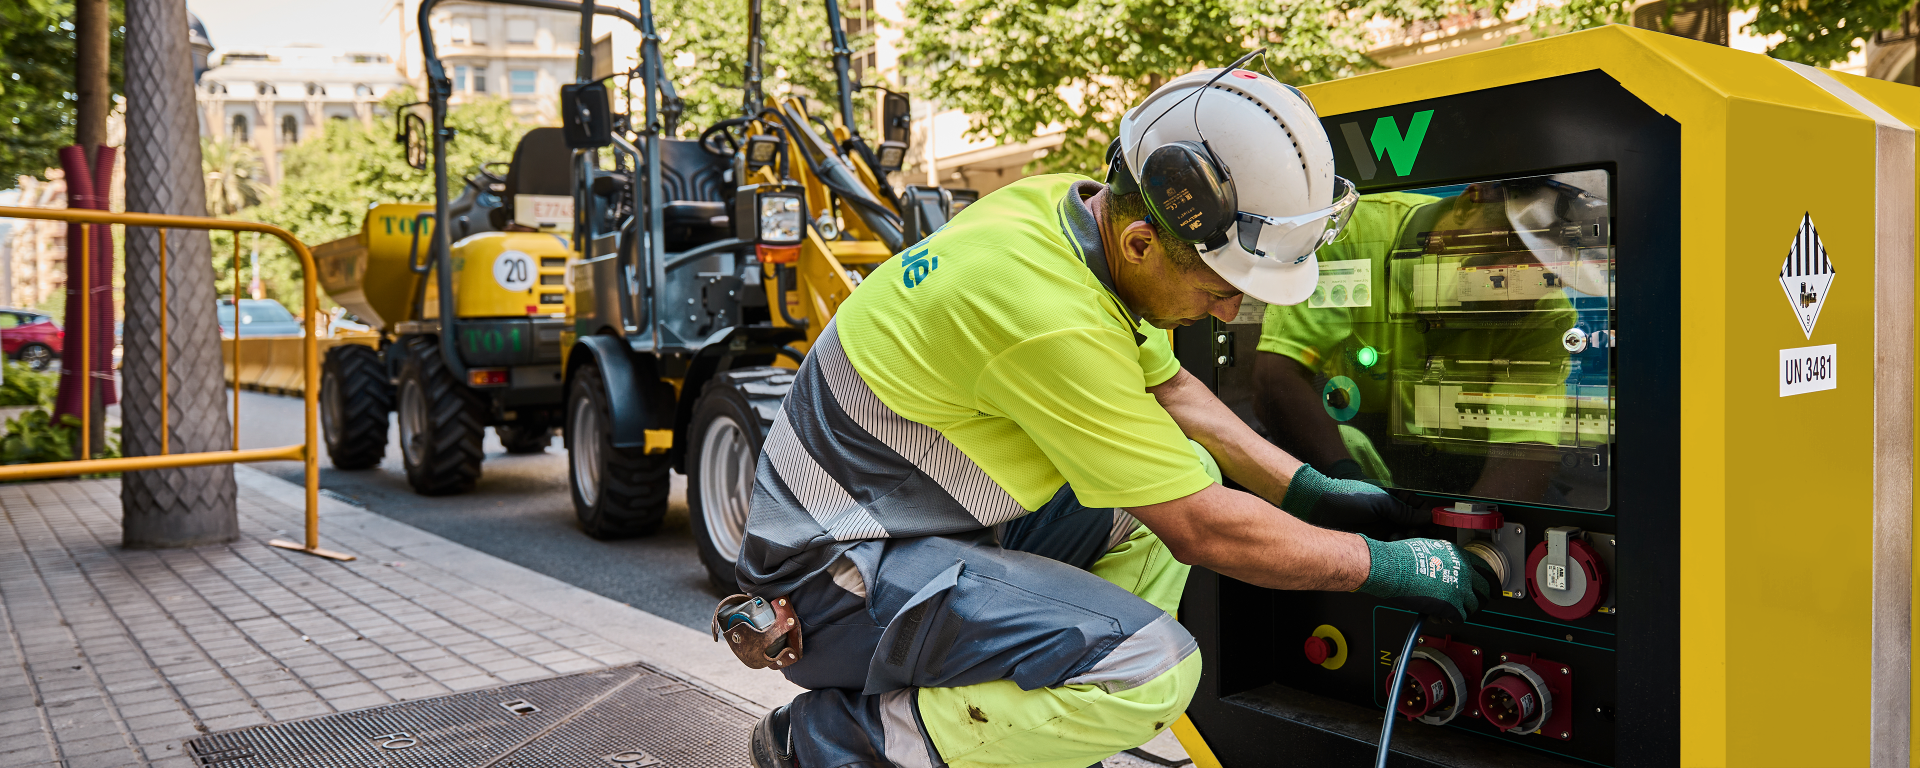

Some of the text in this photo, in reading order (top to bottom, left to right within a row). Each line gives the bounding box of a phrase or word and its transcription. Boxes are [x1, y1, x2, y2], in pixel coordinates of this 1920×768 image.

[1189, 219, 1203, 230] 3M
[504, 258, 527, 283] 20
[1785, 354, 1832, 385] UN 3481
[1380, 650, 1392, 666] IN
